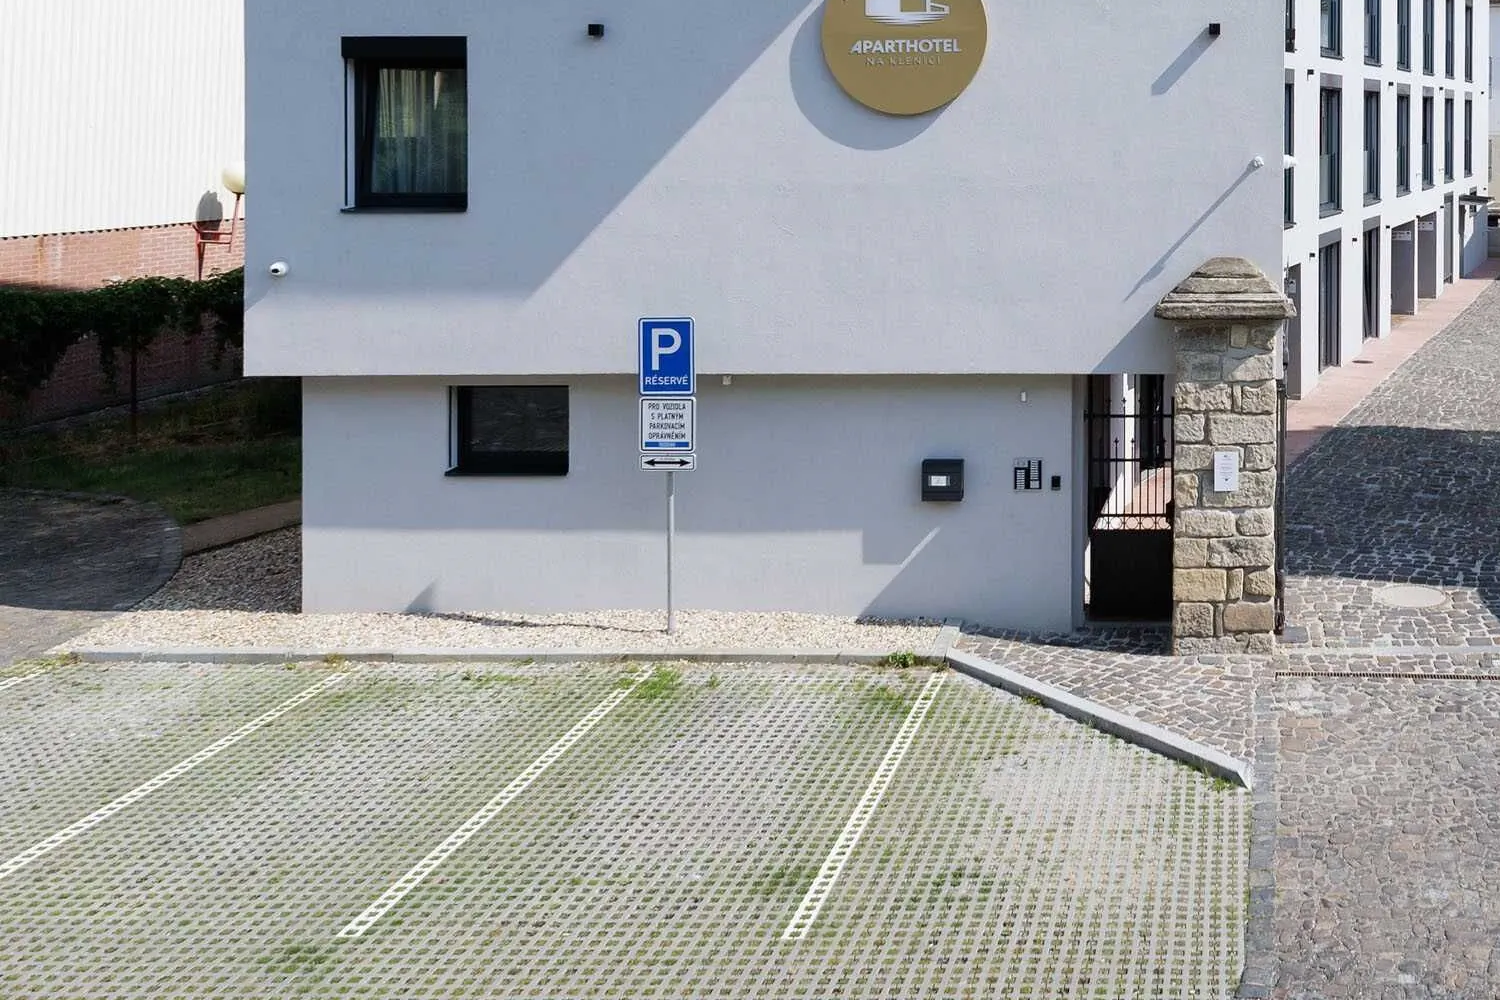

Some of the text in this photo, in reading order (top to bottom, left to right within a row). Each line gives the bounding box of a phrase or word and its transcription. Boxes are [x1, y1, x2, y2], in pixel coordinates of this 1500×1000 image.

[851, 38, 962, 54] APARTHOTEL
[865, 56, 885, 66] NA
[651, 328, 682, 371] P
[645, 374, 689, 385] RÉSERVÉ
[648, 402, 686, 410] PRO VOZIDLA
